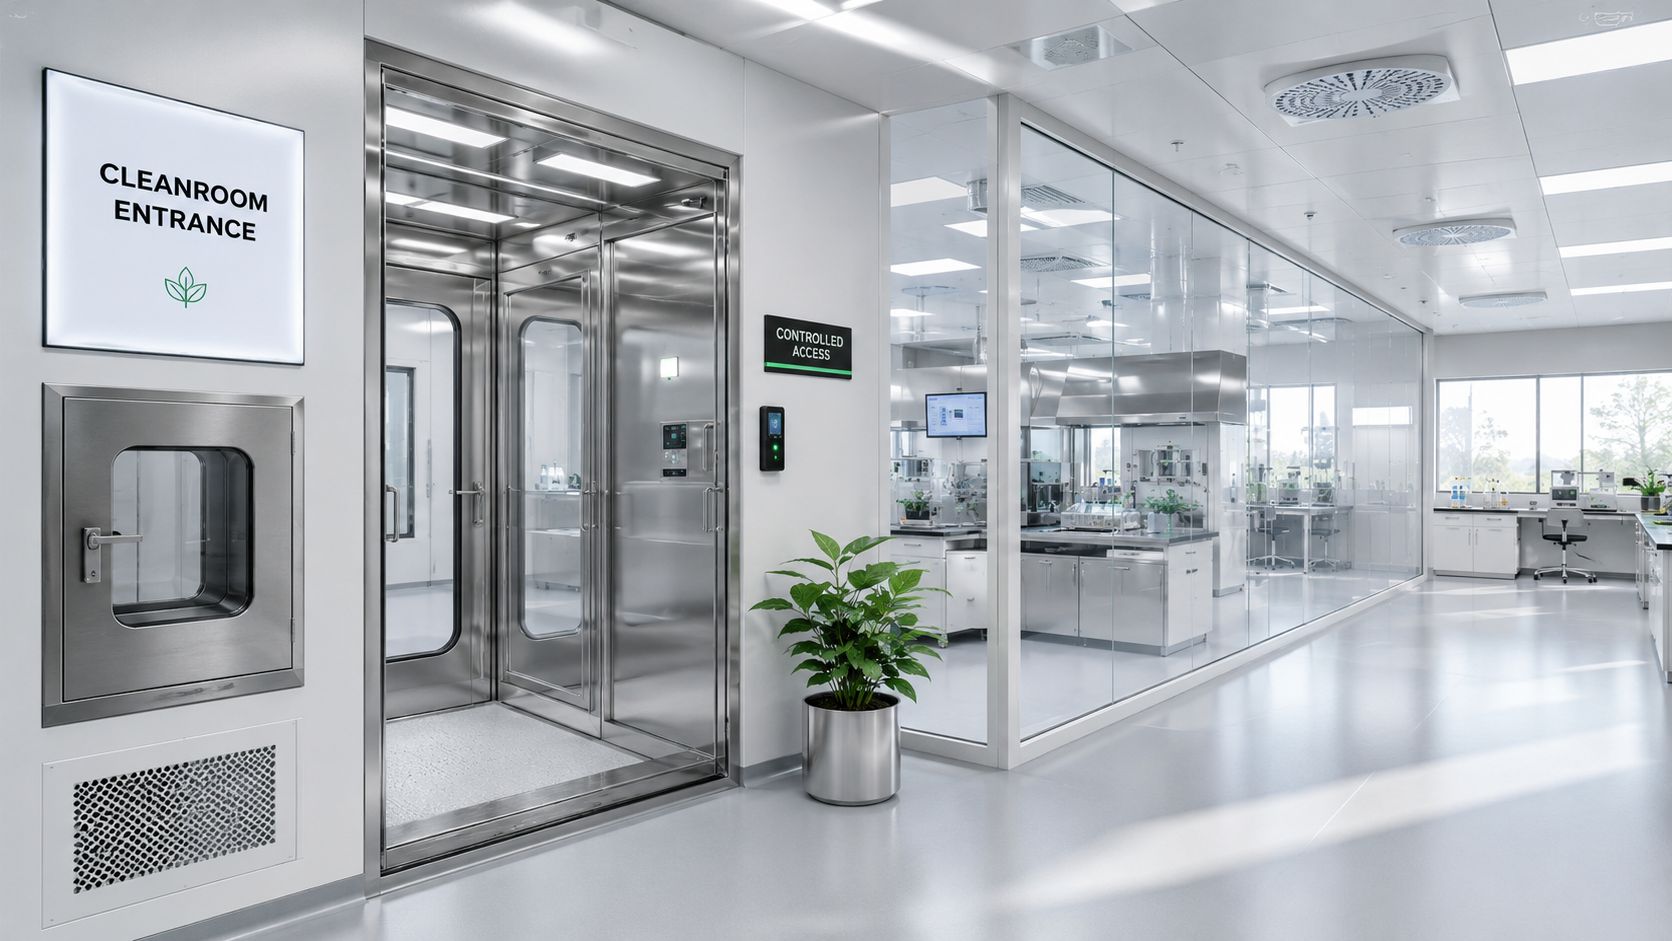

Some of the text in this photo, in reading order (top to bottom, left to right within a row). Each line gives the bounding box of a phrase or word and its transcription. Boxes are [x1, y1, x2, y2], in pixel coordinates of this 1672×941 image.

[99, 163, 268, 212] CLEANROOM
[115, 199, 256, 241] ENTRANCE
[776, 327, 843, 348] CONTROLLED
[792, 345, 831, 360] ACCESS
